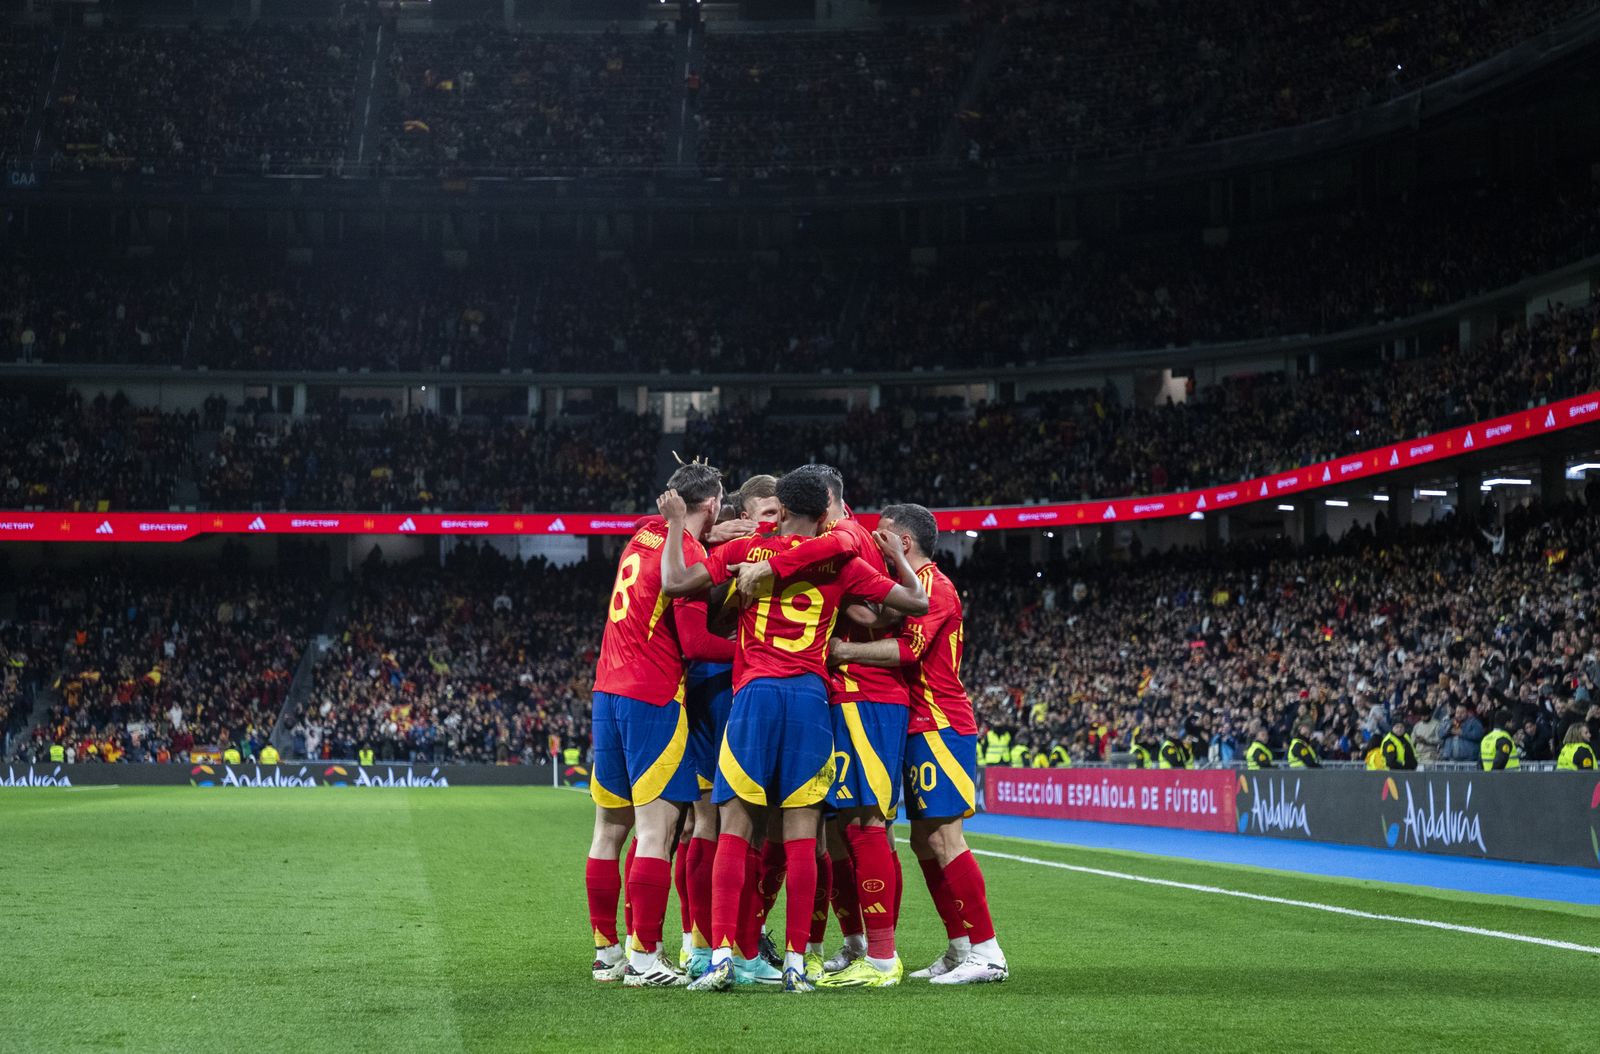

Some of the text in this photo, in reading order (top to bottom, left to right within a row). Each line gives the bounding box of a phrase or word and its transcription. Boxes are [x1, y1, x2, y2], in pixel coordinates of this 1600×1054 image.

[609, 552, 641, 624] 8
[754, 575, 825, 653] 19
[221, 765, 317, 788] Andalucía
[355, 765, 449, 788] Andalucía
[910, 761, 937, 792] 20
[997, 777, 1063, 805] SELECCIÓN
[1068, 778, 1135, 808] ESPAÑOLA
[1141, 786, 1159, 811] DE
[1165, 779, 1217, 814] FÚTBOL
[1251, 776, 1311, 837] Andalucía
[1403, 779, 1488, 853] Andalucía
